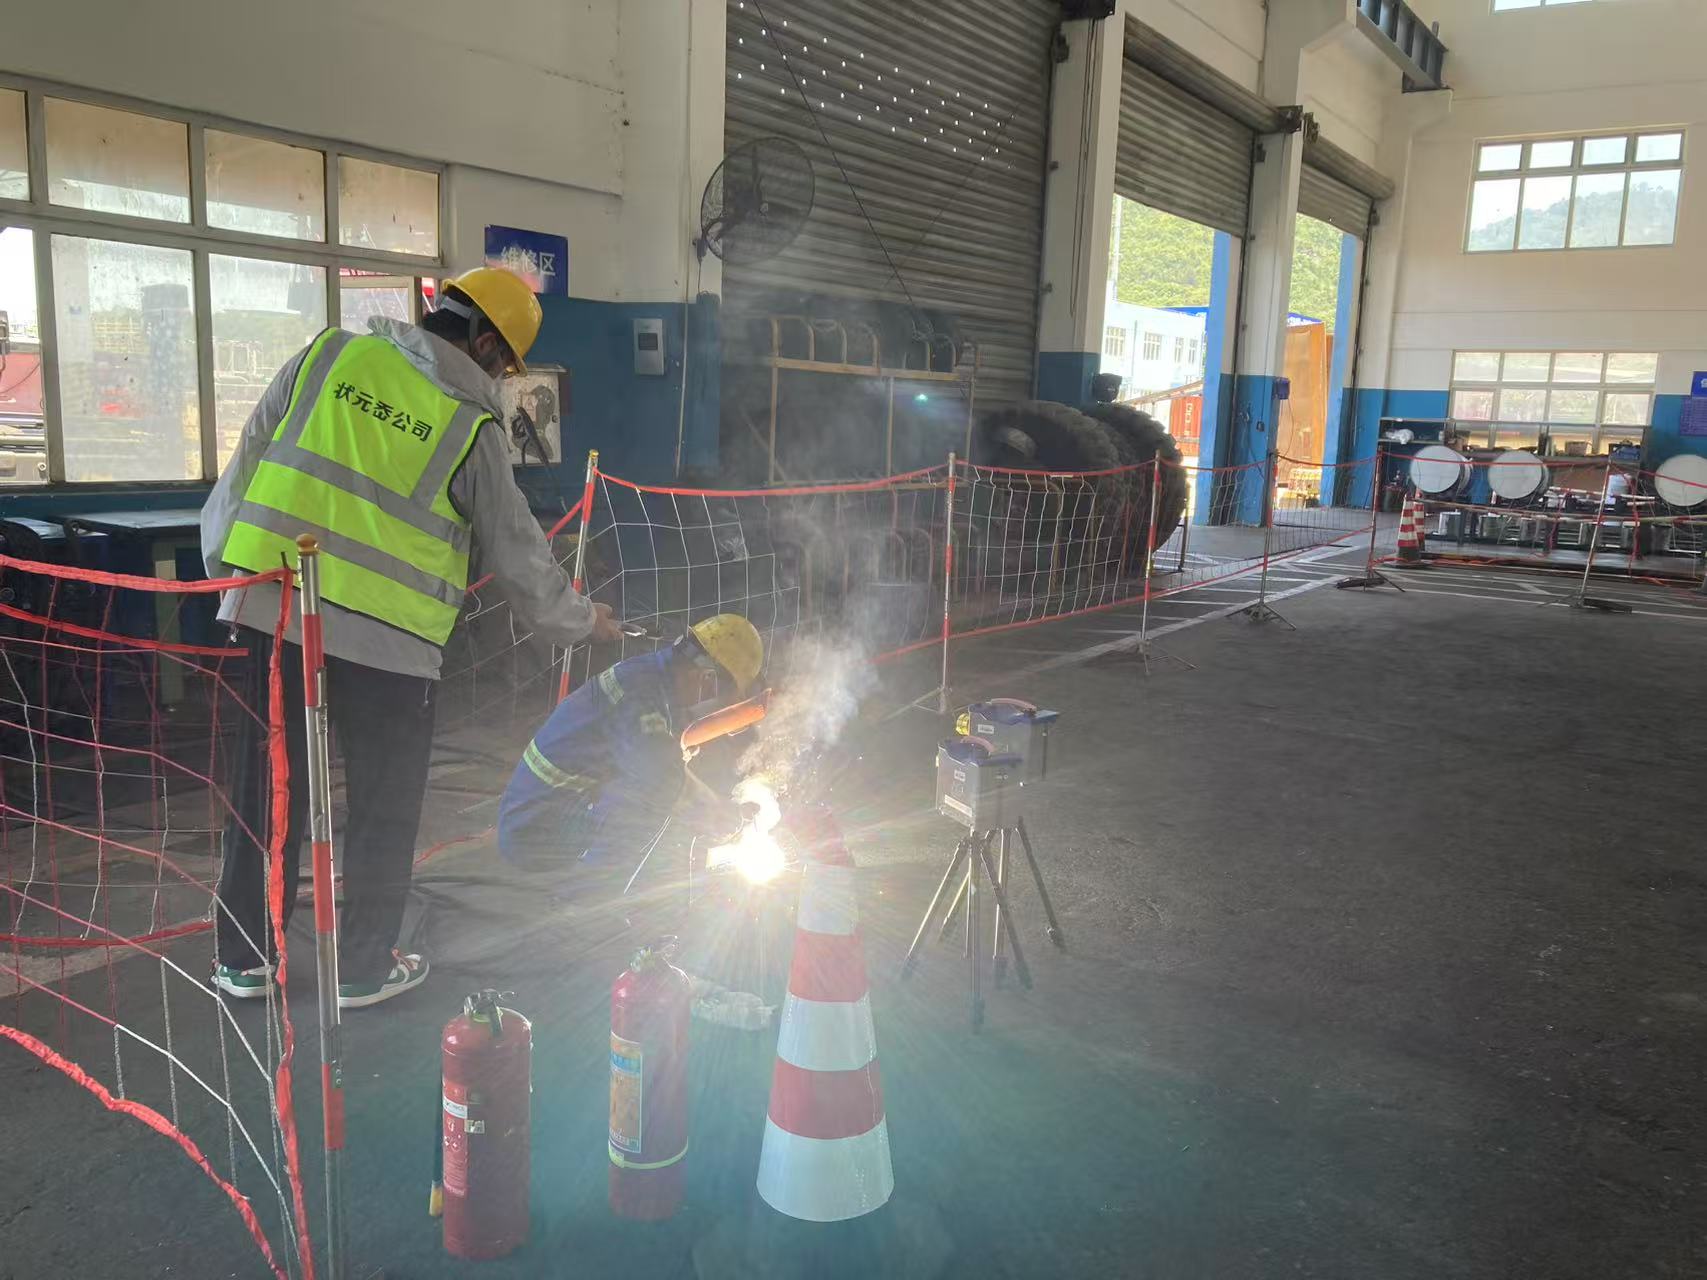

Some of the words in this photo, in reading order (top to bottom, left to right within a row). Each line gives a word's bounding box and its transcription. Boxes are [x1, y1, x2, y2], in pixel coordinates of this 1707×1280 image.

[500, 246, 556, 276] 维修区
[334, 382, 433, 442] 状元岙公司
